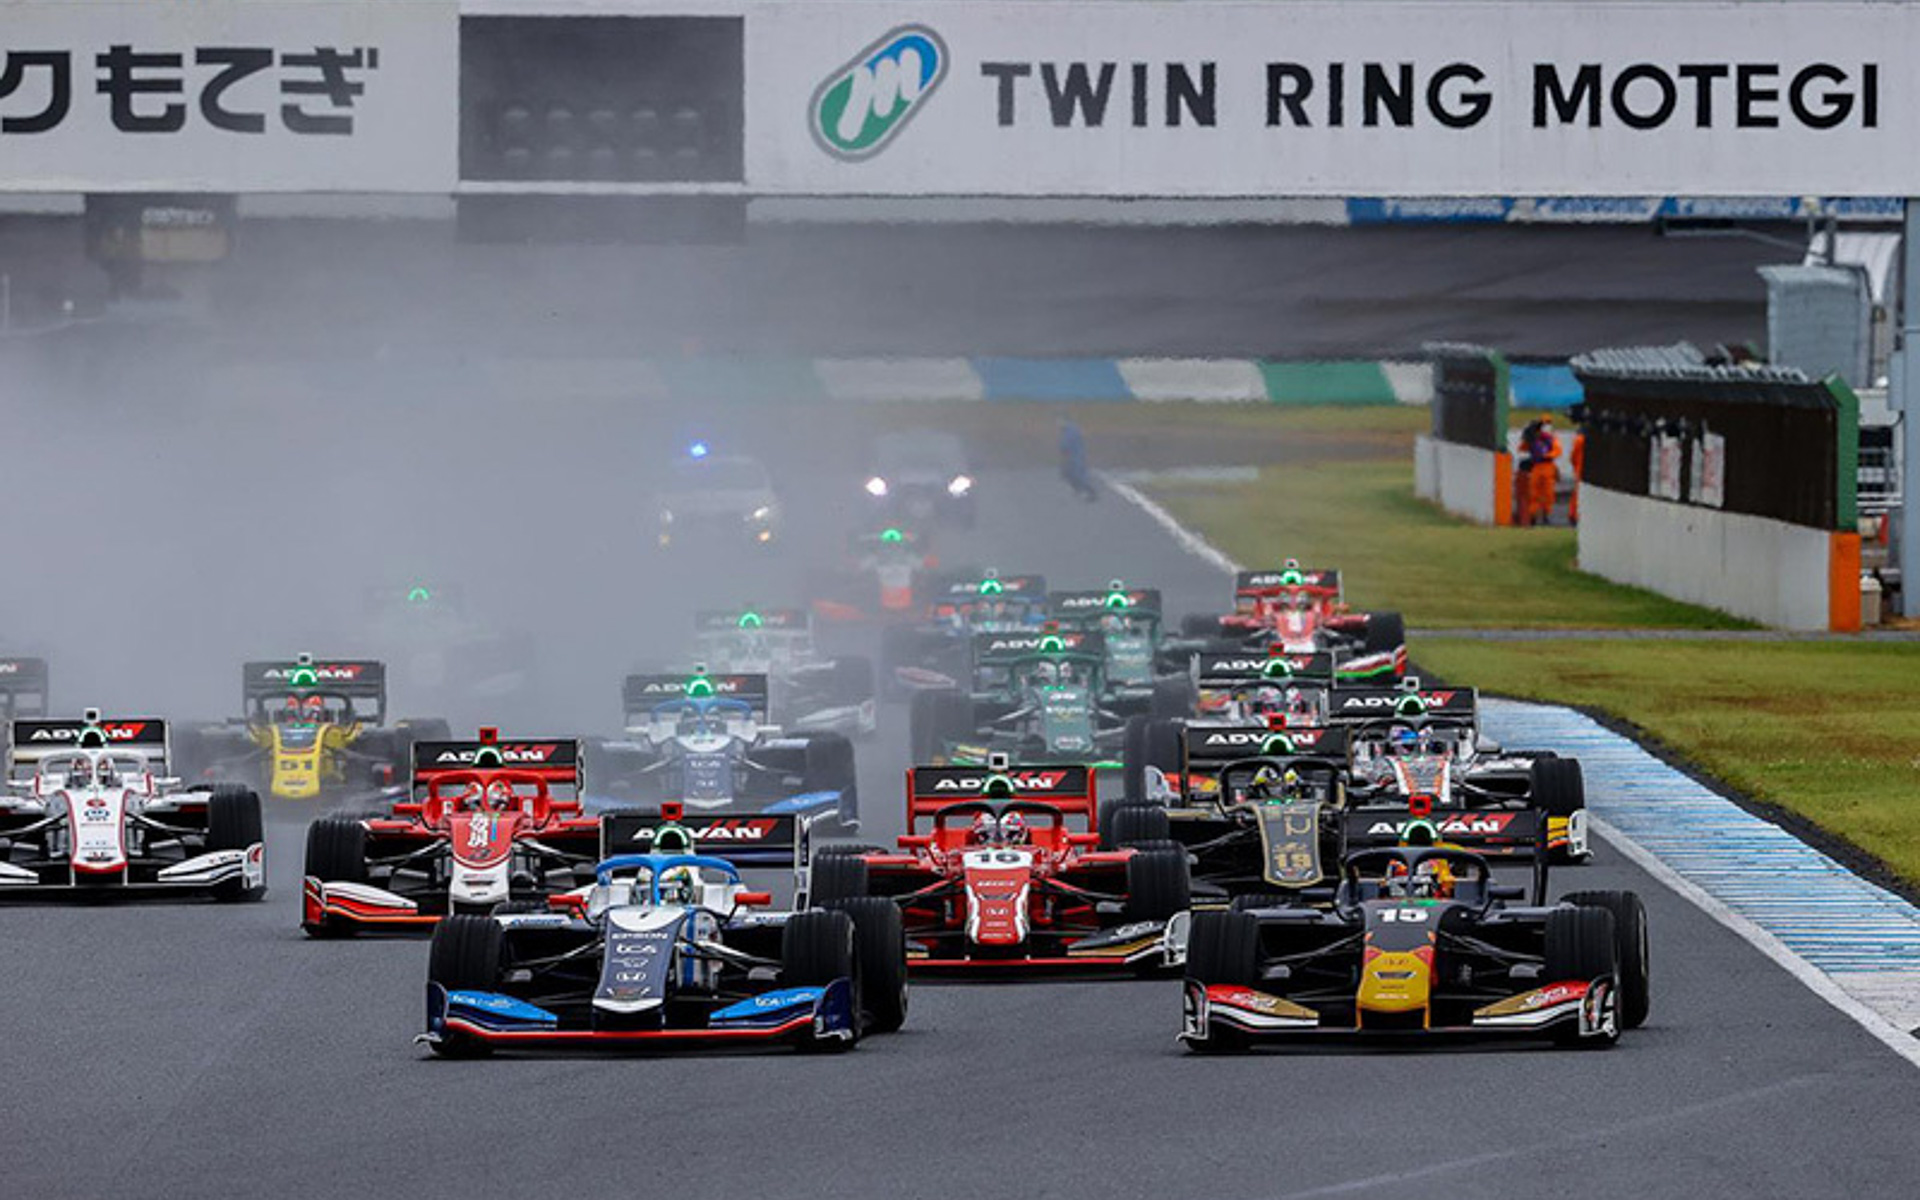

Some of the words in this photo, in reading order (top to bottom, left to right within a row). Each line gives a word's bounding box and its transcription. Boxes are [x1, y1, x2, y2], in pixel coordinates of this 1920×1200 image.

[981, 61, 1217, 128] TWIN
[1266, 62, 1493, 130] RING
[1532, 62, 1879, 131] MOTEGI
[990, 639, 1075, 650] ADVN
[1211, 660, 1305, 670] ADVN
[1343, 697, 1444, 707] ADVN
[1204, 733, 1316, 745] ADVN
[436, 750, 545, 762] ADAN
[934, 777, 1054, 789] ADAN
[632, 826, 763, 841] AVAN
[1376, 908, 1430, 922] 15
